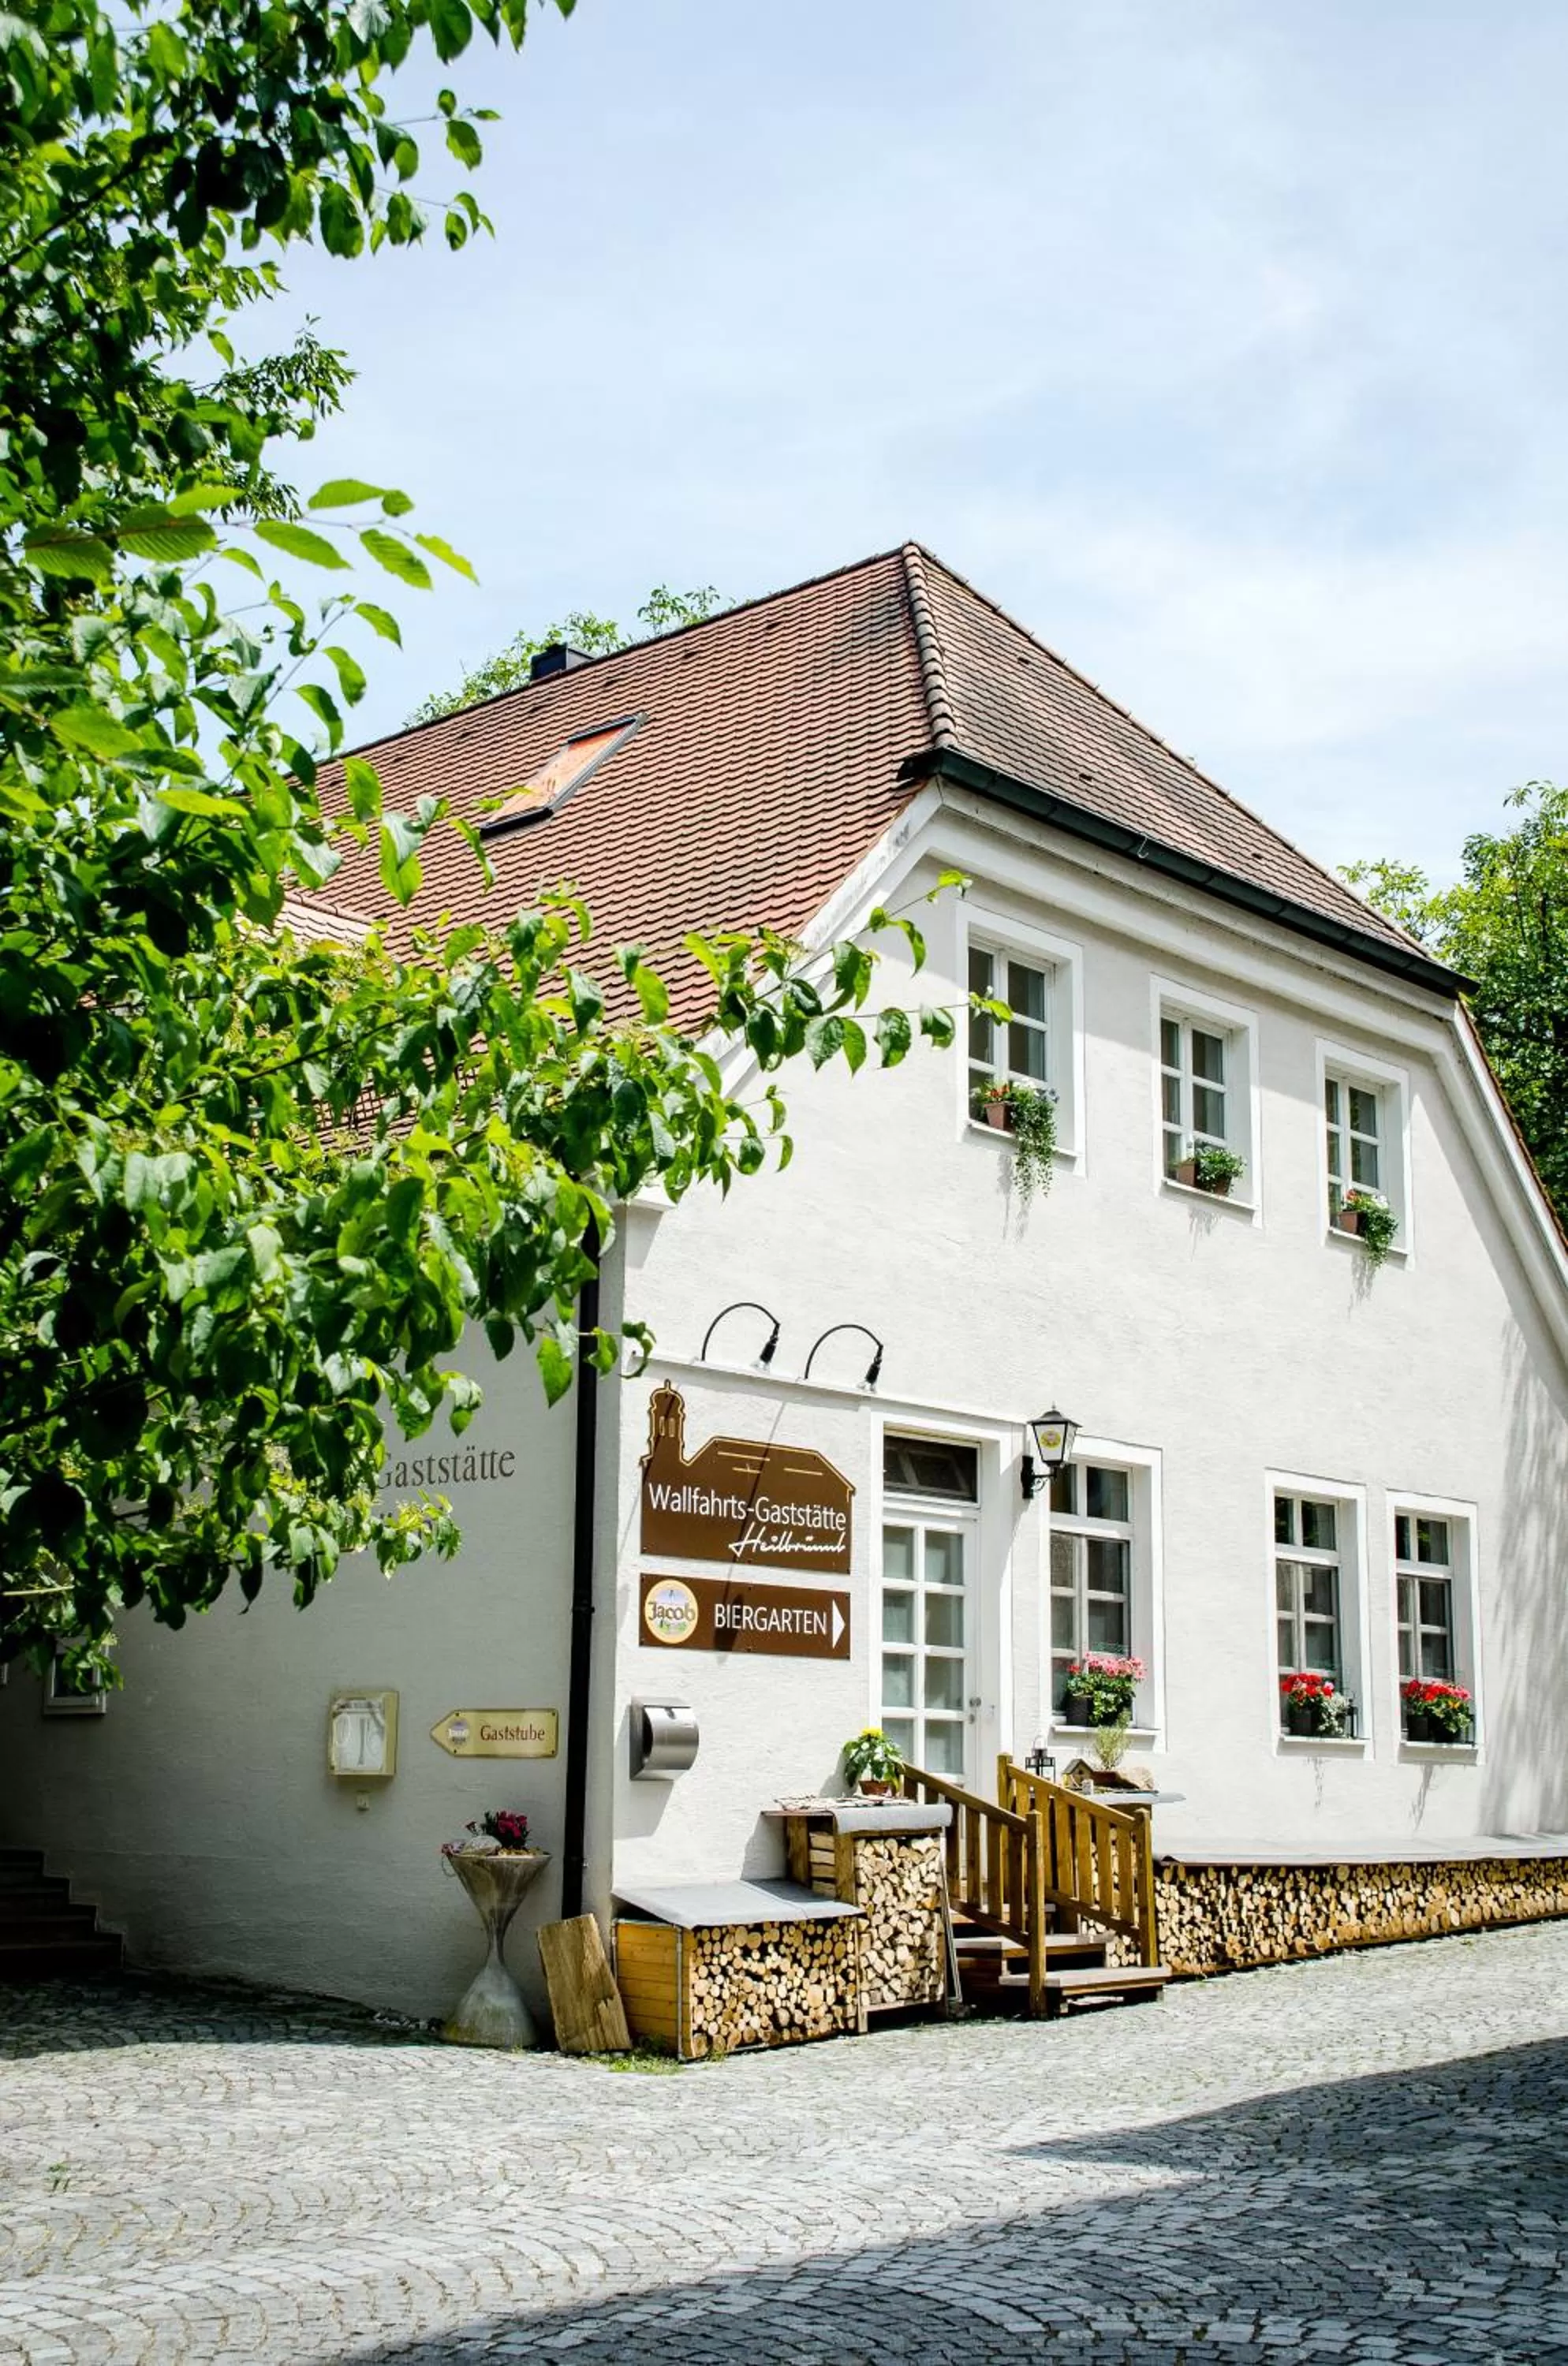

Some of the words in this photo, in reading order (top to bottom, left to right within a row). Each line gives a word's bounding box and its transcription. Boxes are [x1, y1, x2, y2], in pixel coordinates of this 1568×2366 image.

[648, 1483, 846, 1530] Wallfahrts-Gaststätte
[648, 1601, 696, 1621] Jacob
[714, 1603, 827, 1635] BIERGARTEN
[480, 1723, 545, 1741] Gaststube
